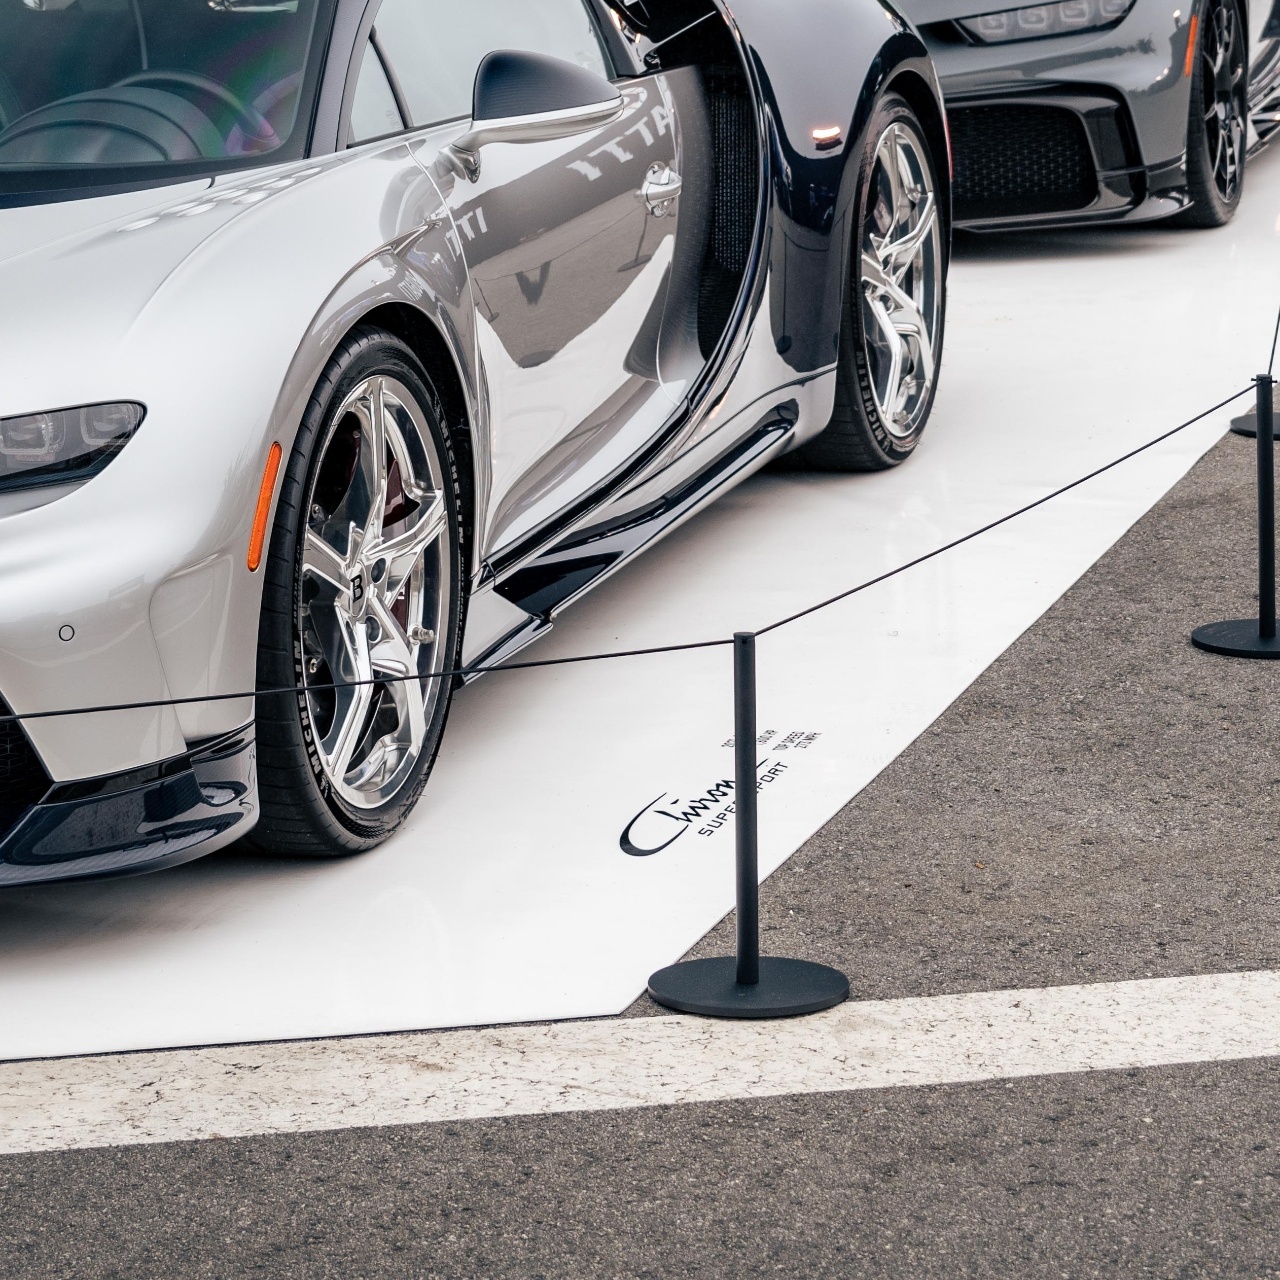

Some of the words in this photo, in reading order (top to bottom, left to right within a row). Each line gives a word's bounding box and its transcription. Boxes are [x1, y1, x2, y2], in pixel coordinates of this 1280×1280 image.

[856, 351, 887, 441] MICHELIN
[439, 419, 465, 544] MICHELIN
[294, 640, 322, 775] MICHELIN
[697, 800, 736, 837] SUPE
[756, 761, 789, 794] PORT
